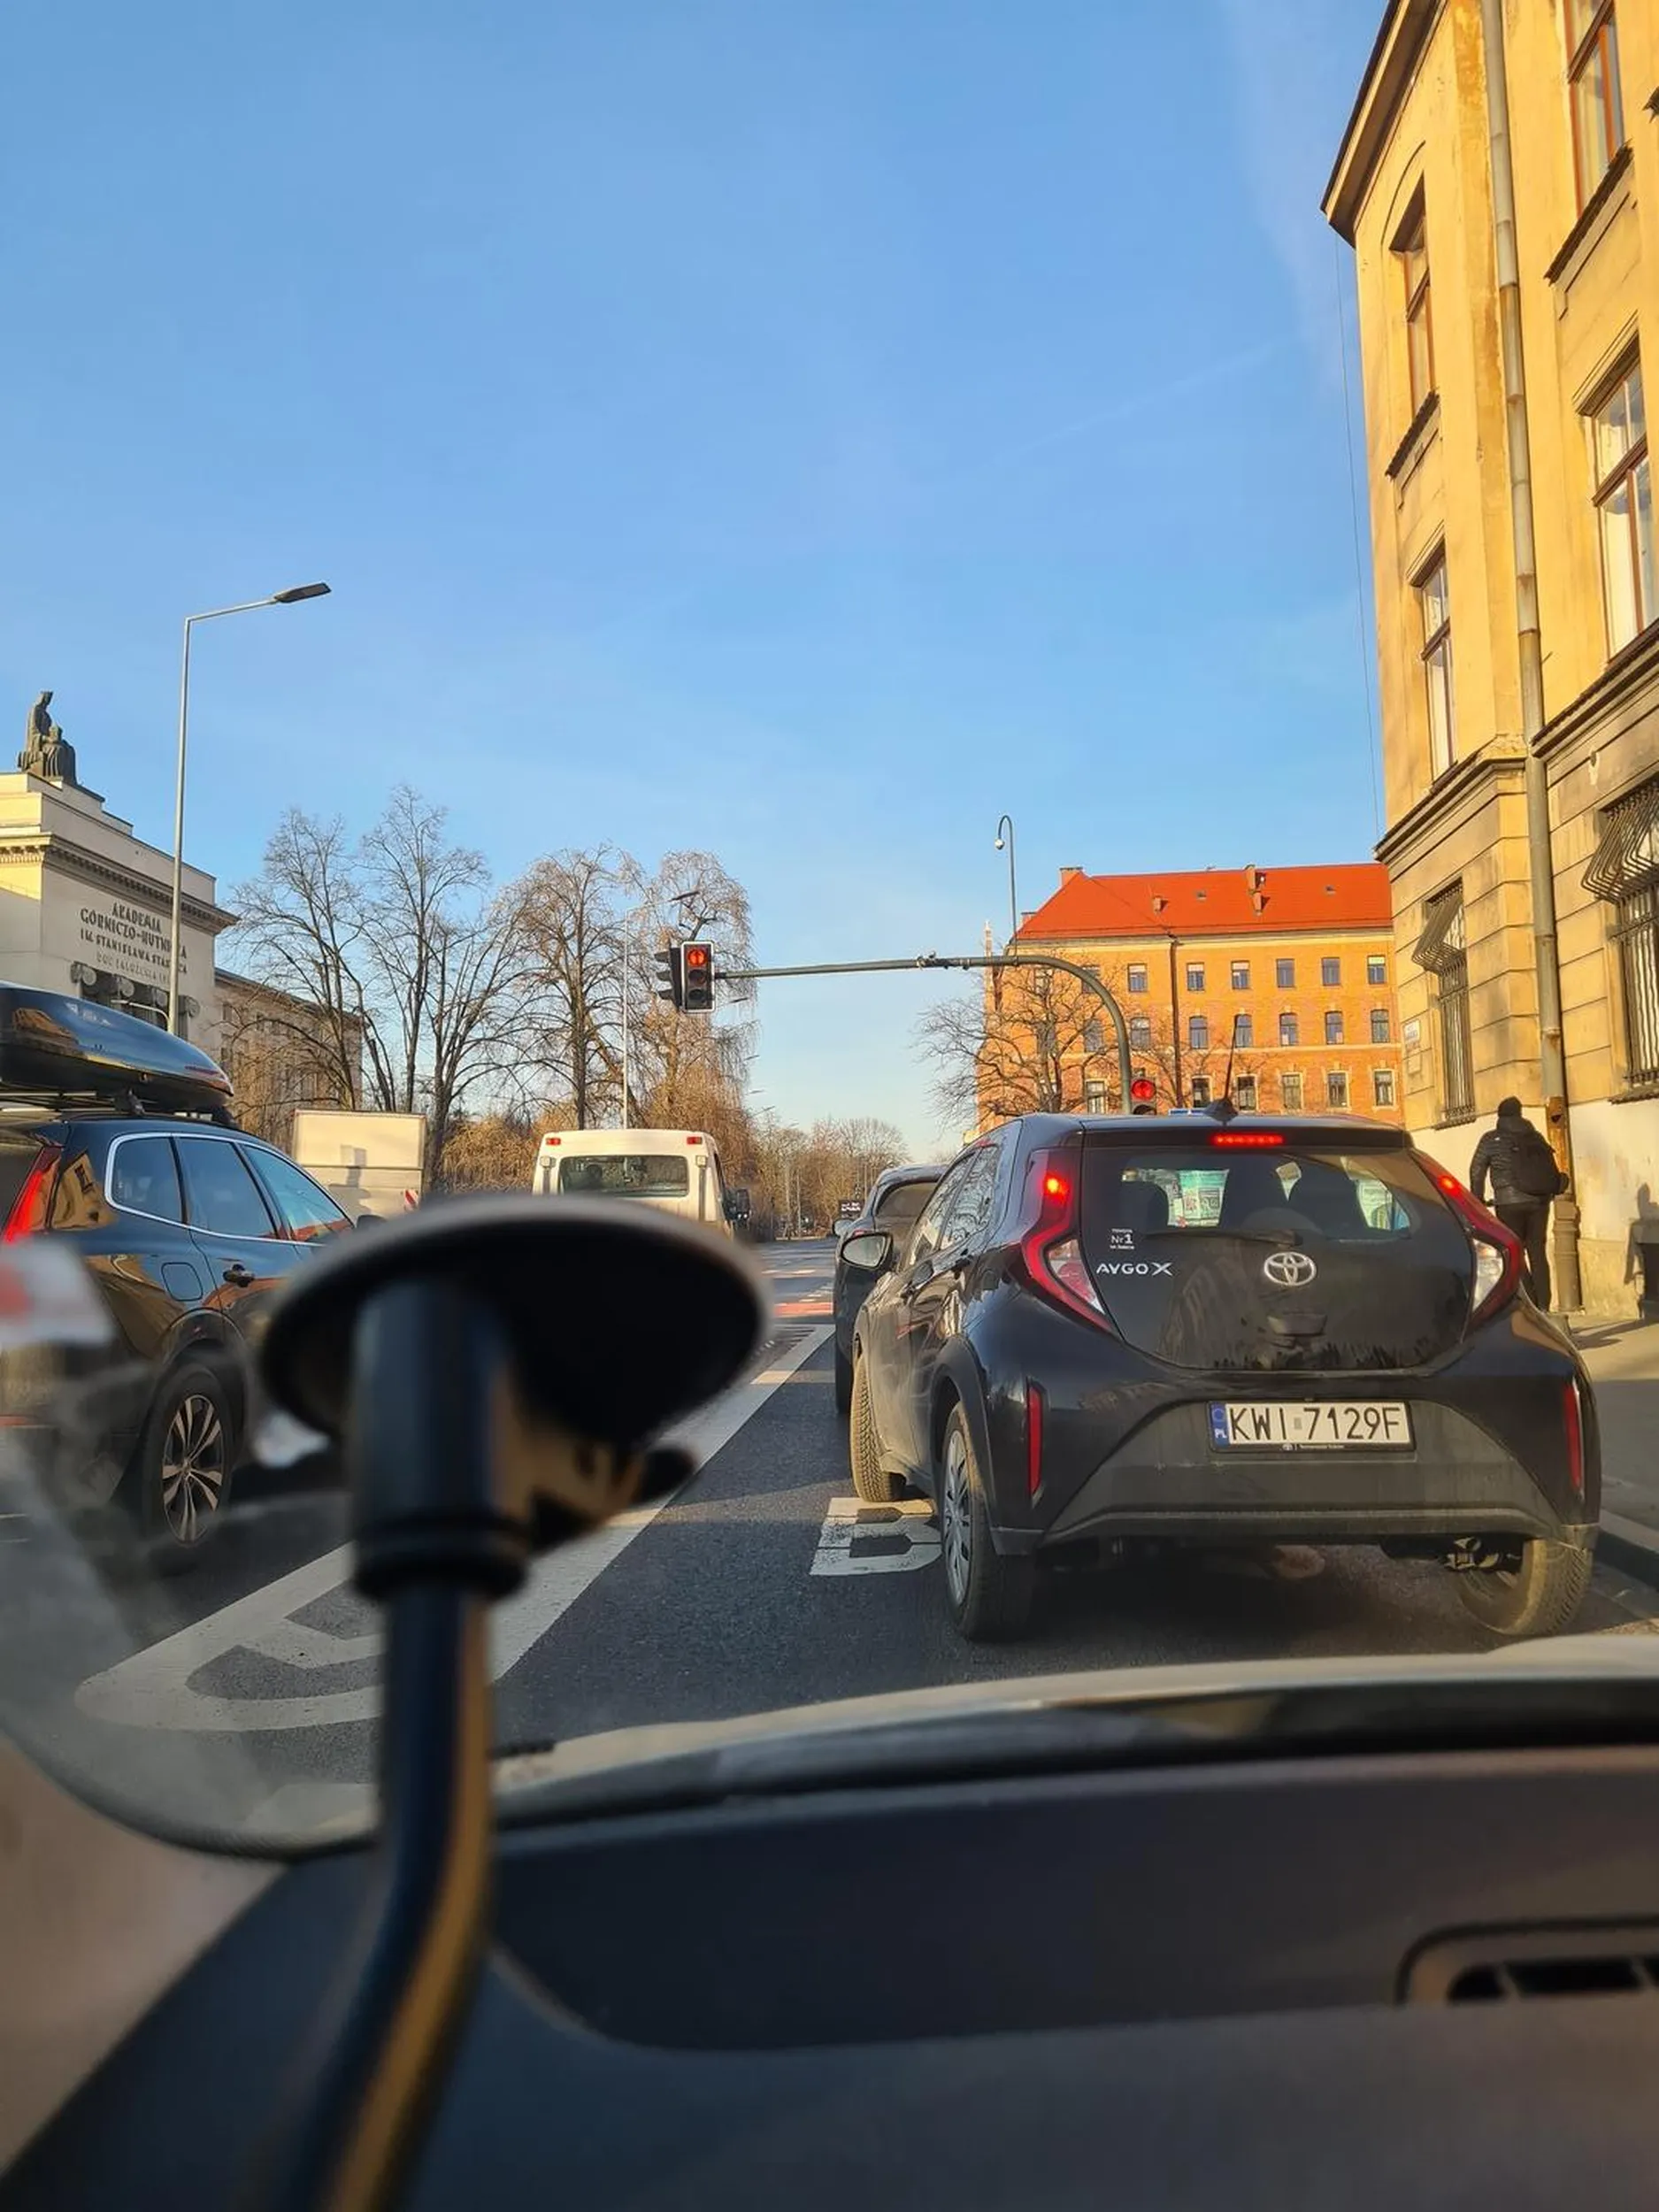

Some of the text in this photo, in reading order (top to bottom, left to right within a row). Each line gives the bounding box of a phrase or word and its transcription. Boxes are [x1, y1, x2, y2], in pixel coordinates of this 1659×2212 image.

[112, 902, 162, 933] AKADEMIA
[1124, 1233, 1133, 1244] 1
[1214, 1428, 1227, 1439] PL
[1230, 1406, 1401, 1440] KWI 7129F
